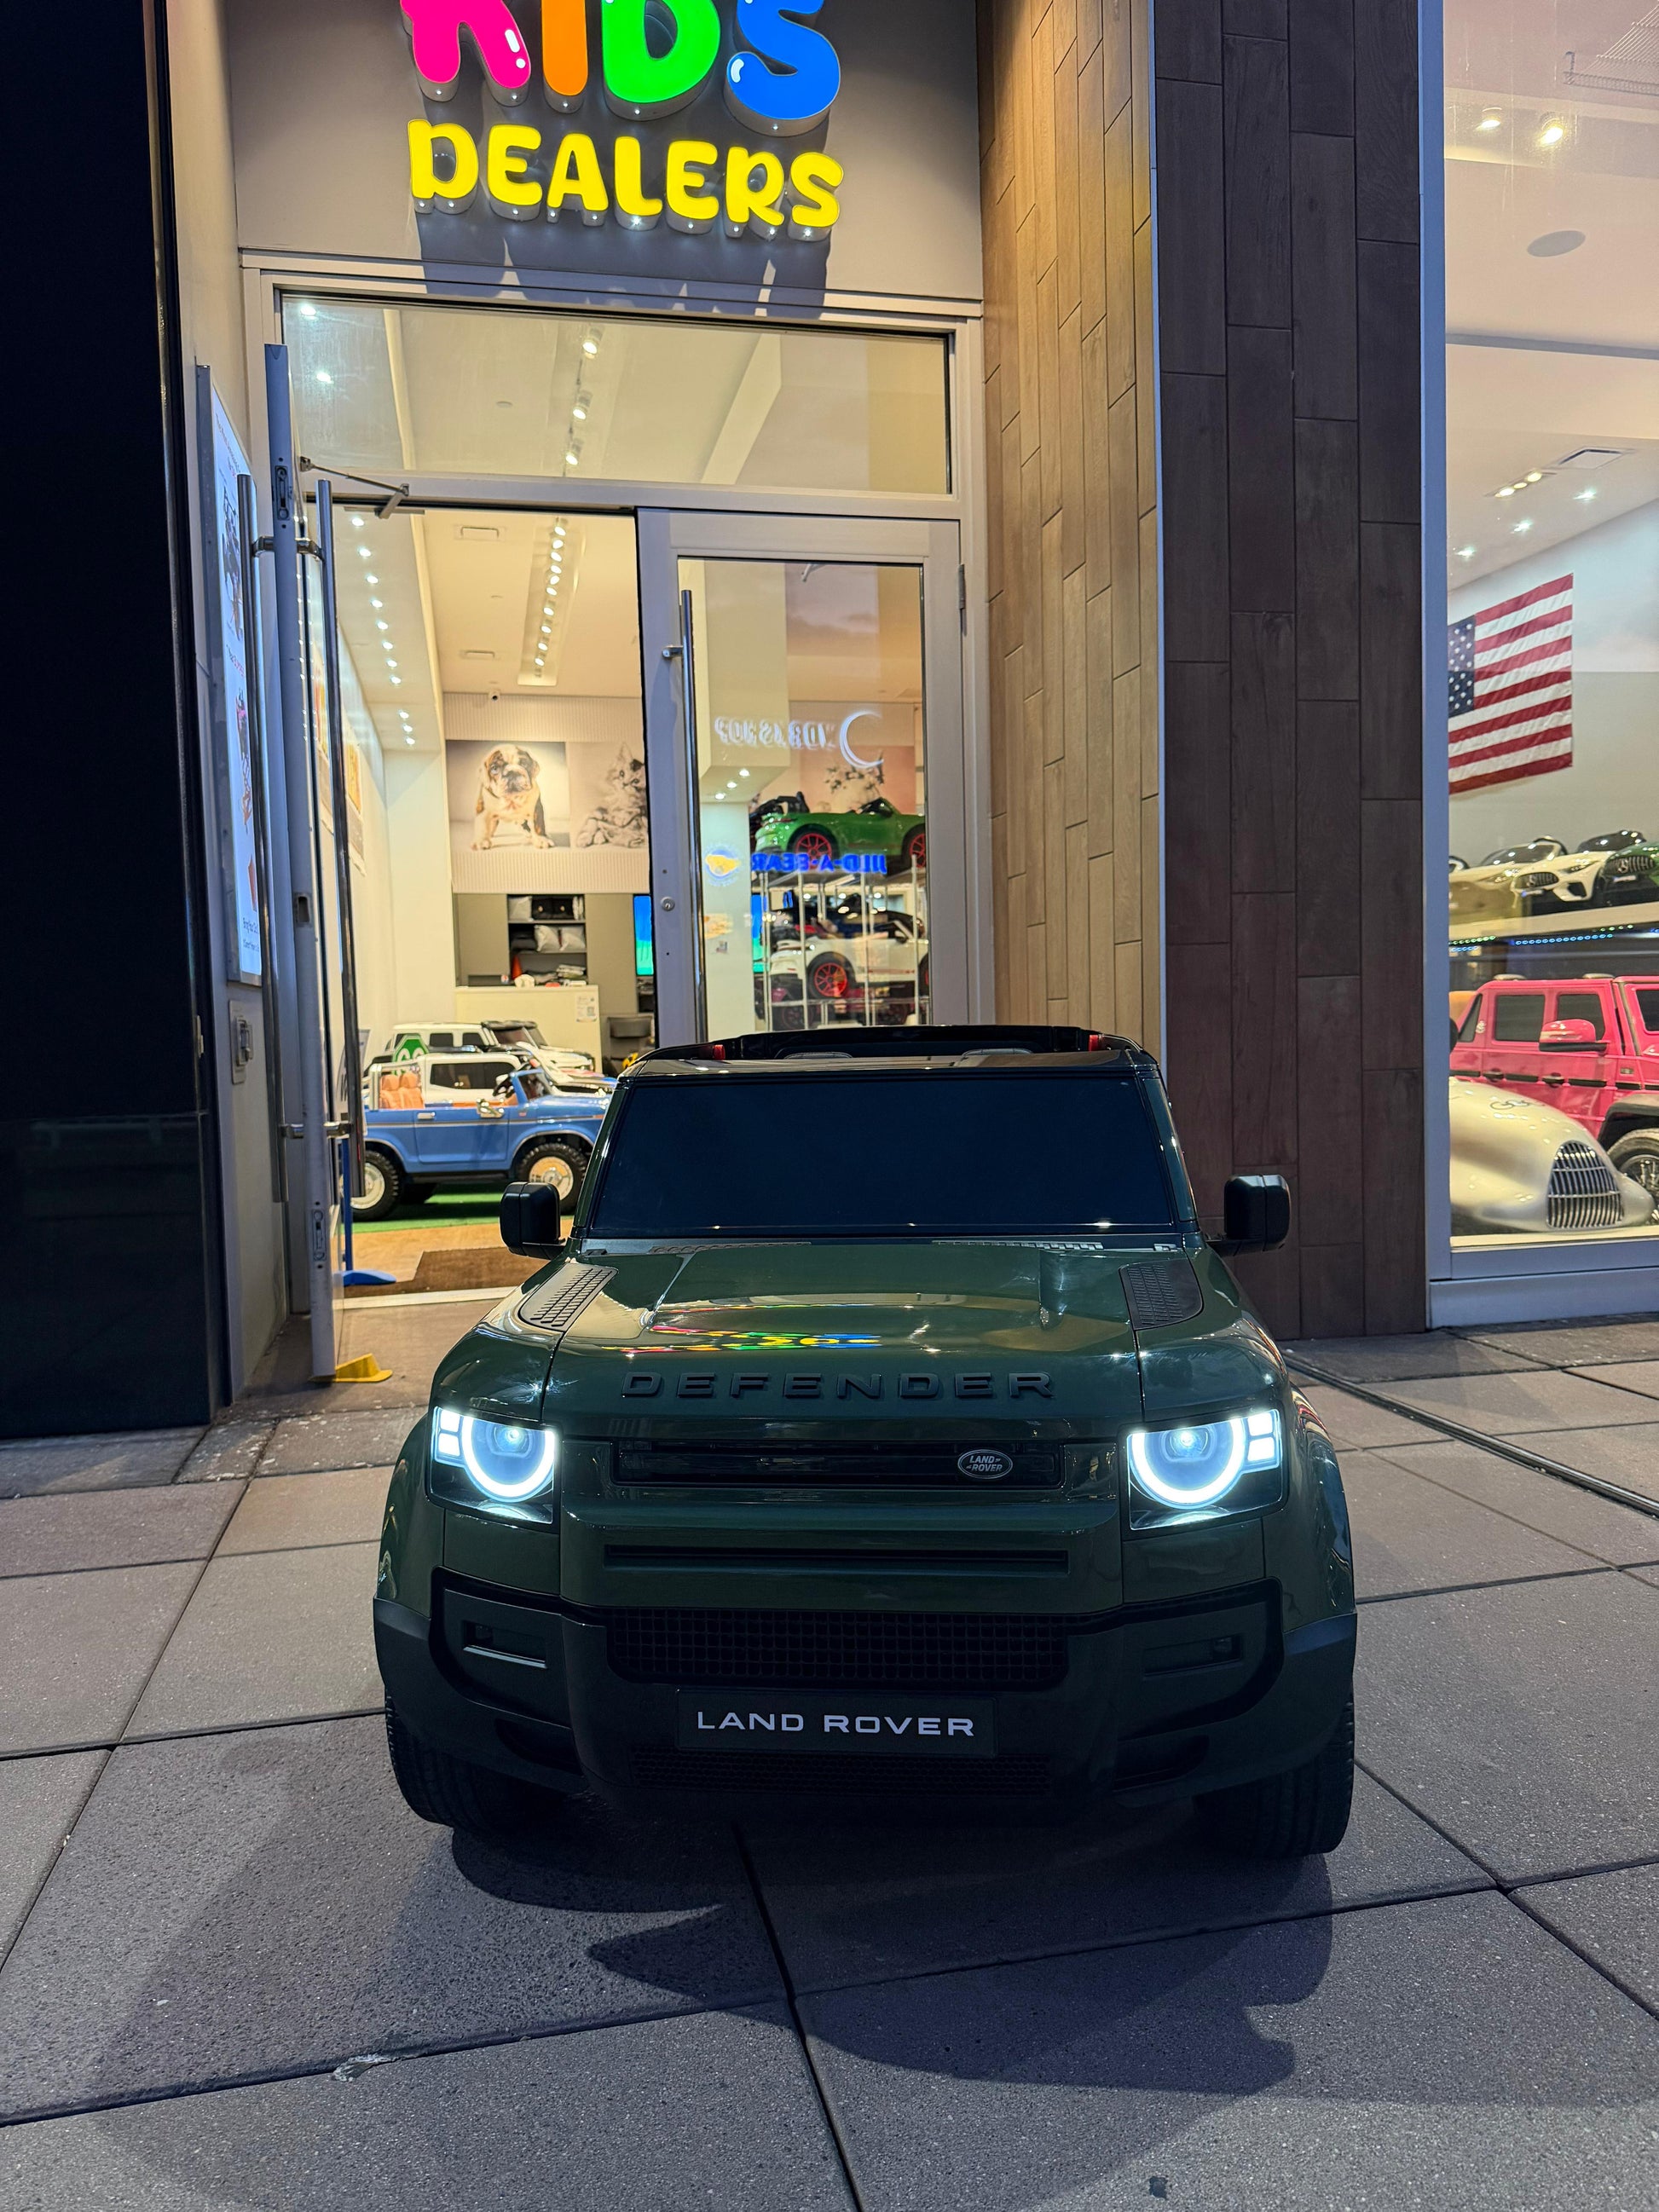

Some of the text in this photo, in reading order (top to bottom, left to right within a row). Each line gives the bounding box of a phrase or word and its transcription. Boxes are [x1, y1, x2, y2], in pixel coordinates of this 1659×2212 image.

[407, 118, 845, 229] DEALERS
[621, 1371, 1055, 1400] DEFENDER
[969, 1455, 996, 1464] LAND
[971, 1464, 1003, 1472] ROVER
[696, 1710, 974, 1737] LAND ROVER
